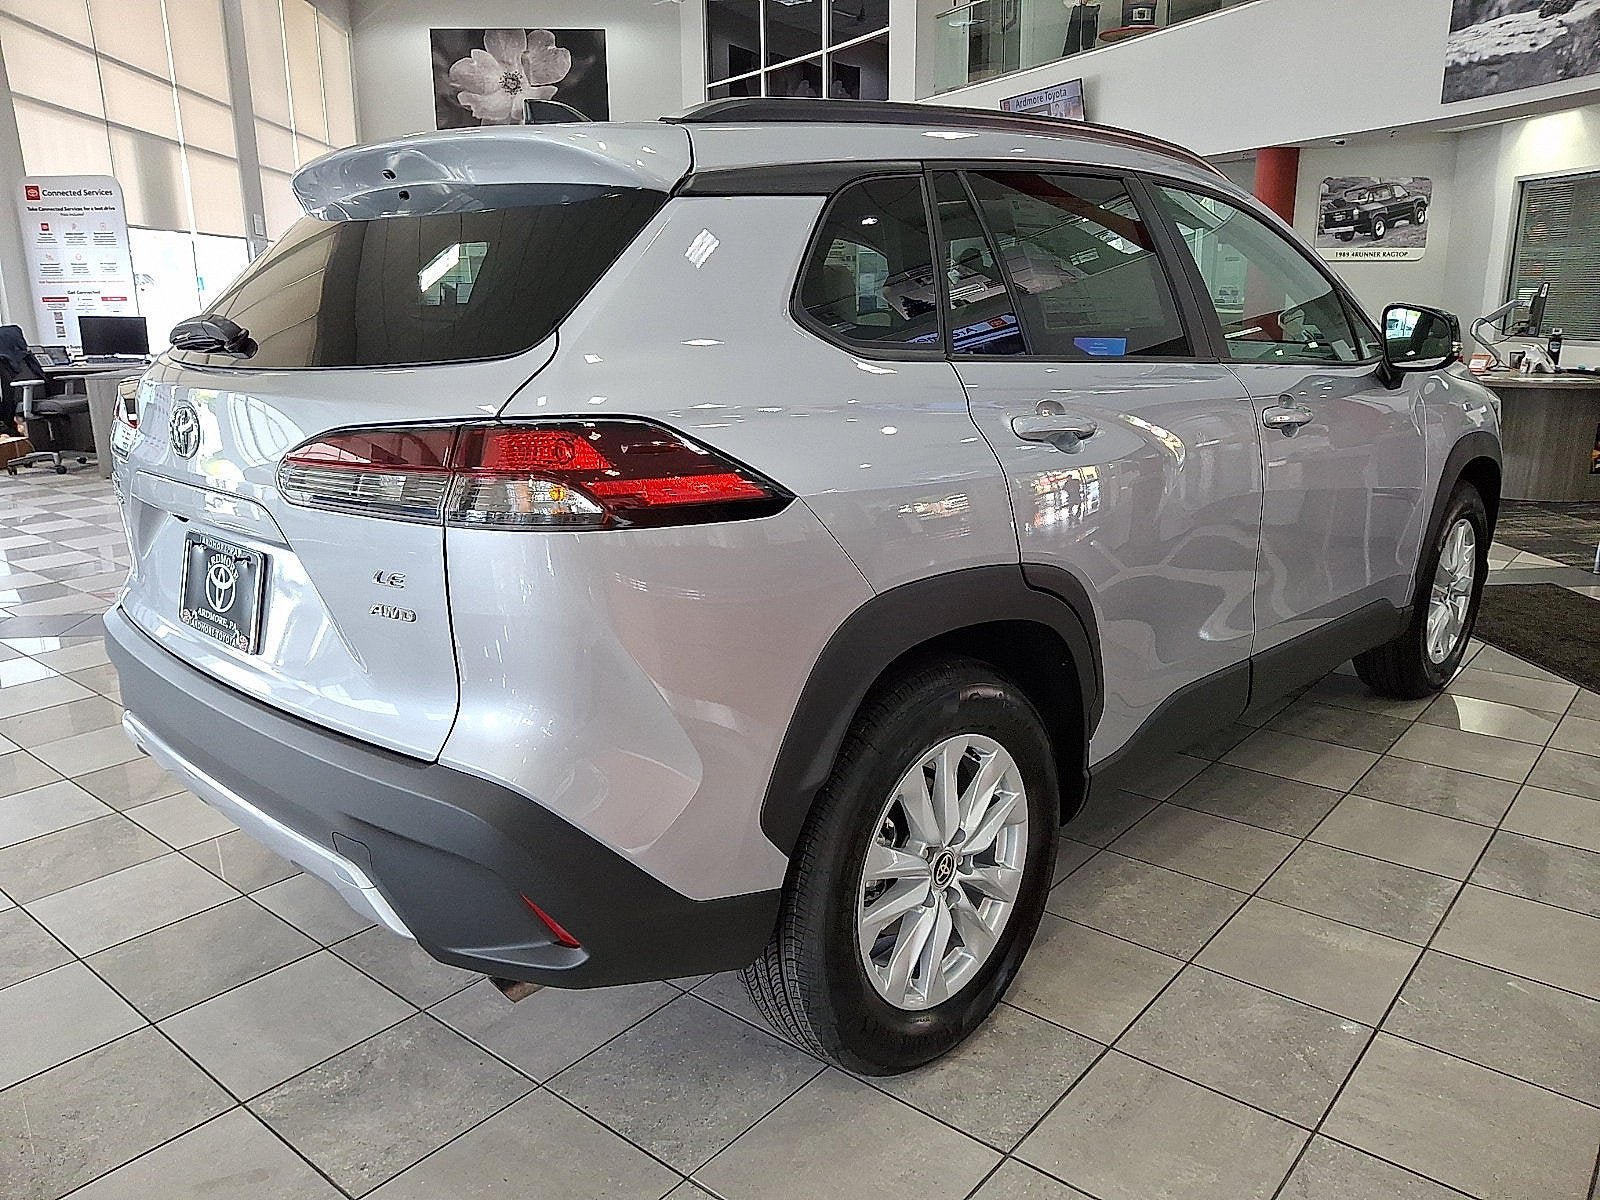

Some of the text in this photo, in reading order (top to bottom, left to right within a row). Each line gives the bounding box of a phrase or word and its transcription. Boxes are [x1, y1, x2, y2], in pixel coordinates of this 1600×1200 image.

[1016, 89, 1067, 108] Ardmore Toyota
[41, 188, 113, 197] Connected Services
[372, 569, 406, 589] LE
[369, 603, 417, 622] AWD
